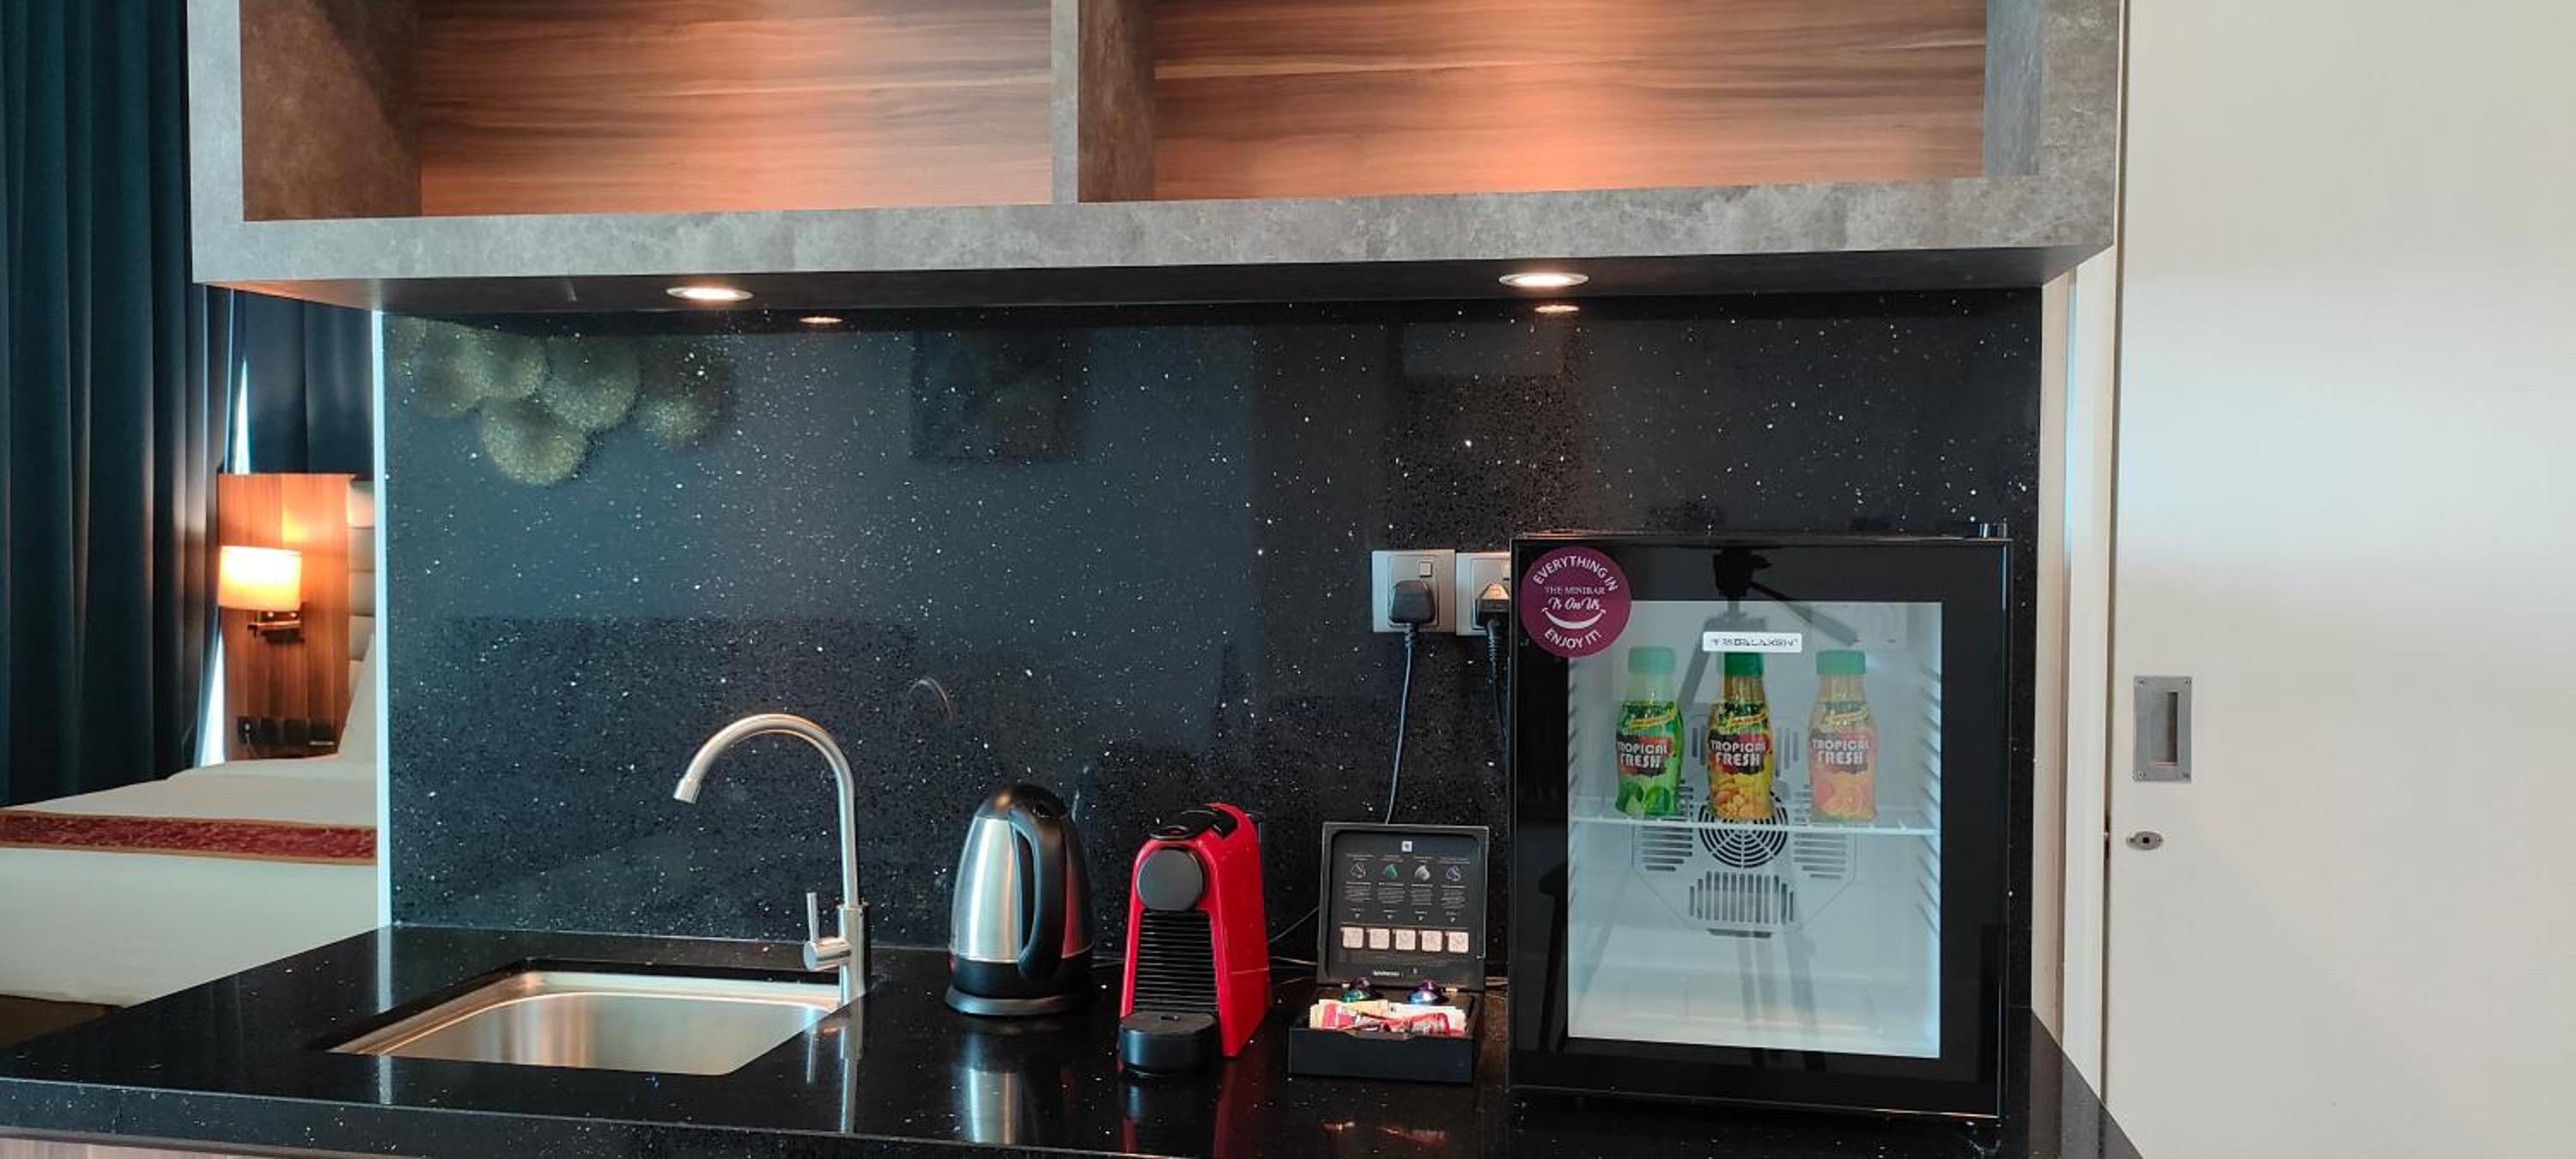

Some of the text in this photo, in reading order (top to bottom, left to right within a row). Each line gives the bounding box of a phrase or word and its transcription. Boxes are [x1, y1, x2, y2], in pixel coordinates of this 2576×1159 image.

[1533, 555, 1619, 592] EVERYTHING IN
[1565, 597, 1582, 610] On
[1545, 628, 1602, 649] ENJOY IT!
[1618, 740, 1668, 755] TROPICAL
[1710, 739, 1766, 753] TROPICAL
[1813, 738, 1869, 752] TROPICAL
[1621, 753, 1661, 768] FRESH
[1716, 751, 1760, 767] FRESH
[1818, 749, 1862, 766] FRESH
